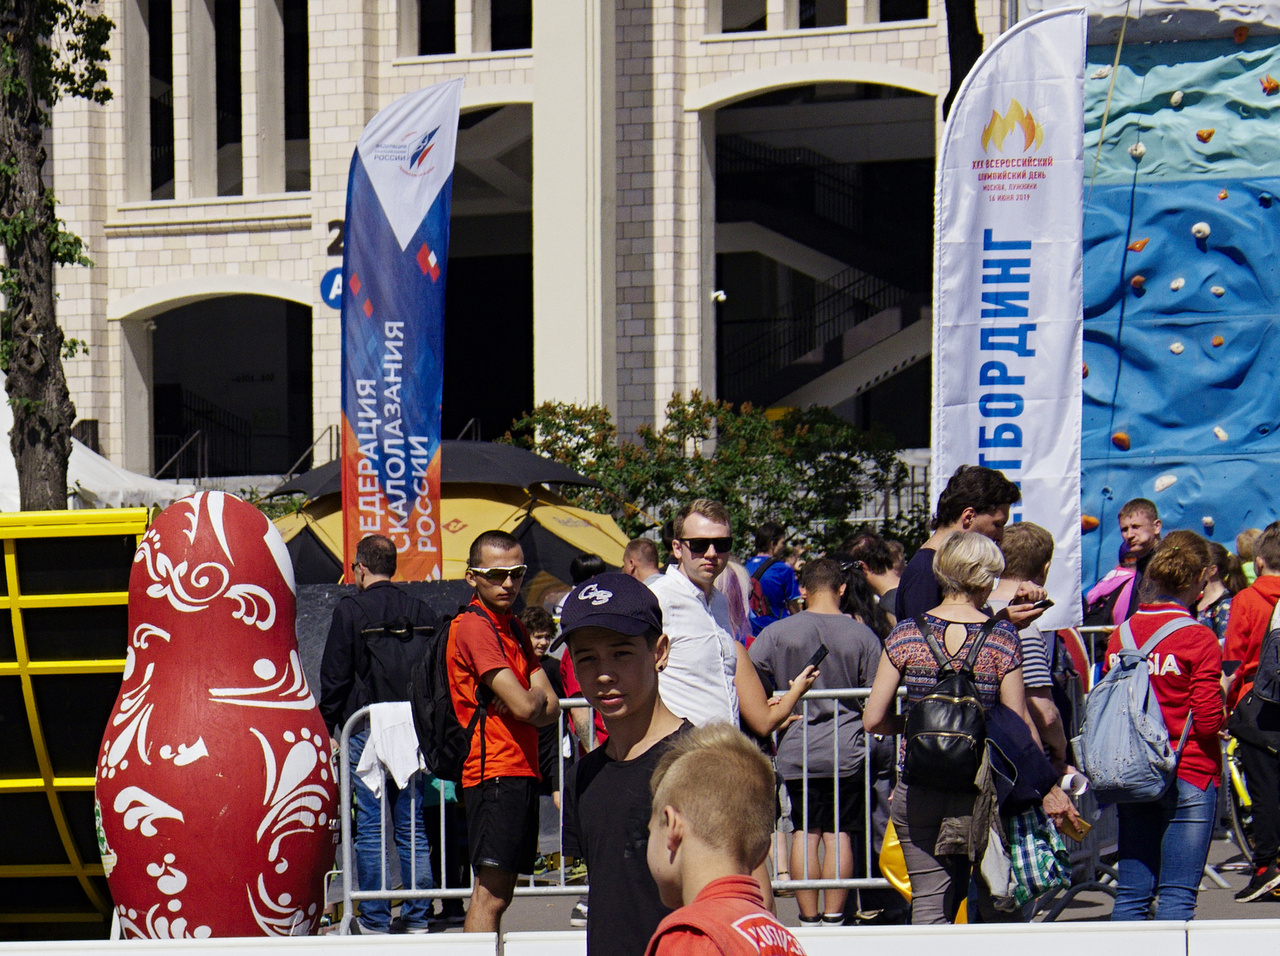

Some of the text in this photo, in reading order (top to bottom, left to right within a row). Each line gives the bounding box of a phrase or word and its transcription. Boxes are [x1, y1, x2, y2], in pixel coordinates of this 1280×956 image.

[986, 156, 1053, 168] ВСЕРОССИЙСКИЙ
[1029, 171, 1046, 180] ДЕНЬ
[327, 219, 345, 256] 2
[978, 228, 1037, 523] ТБОРДИНГ
[356, 379, 382, 540] ЕДЕРАЦИЯ
[383, 321, 411, 554] СКАЛОЛАЗАНИЯ
[408, 436, 438, 552] РОССИИ
